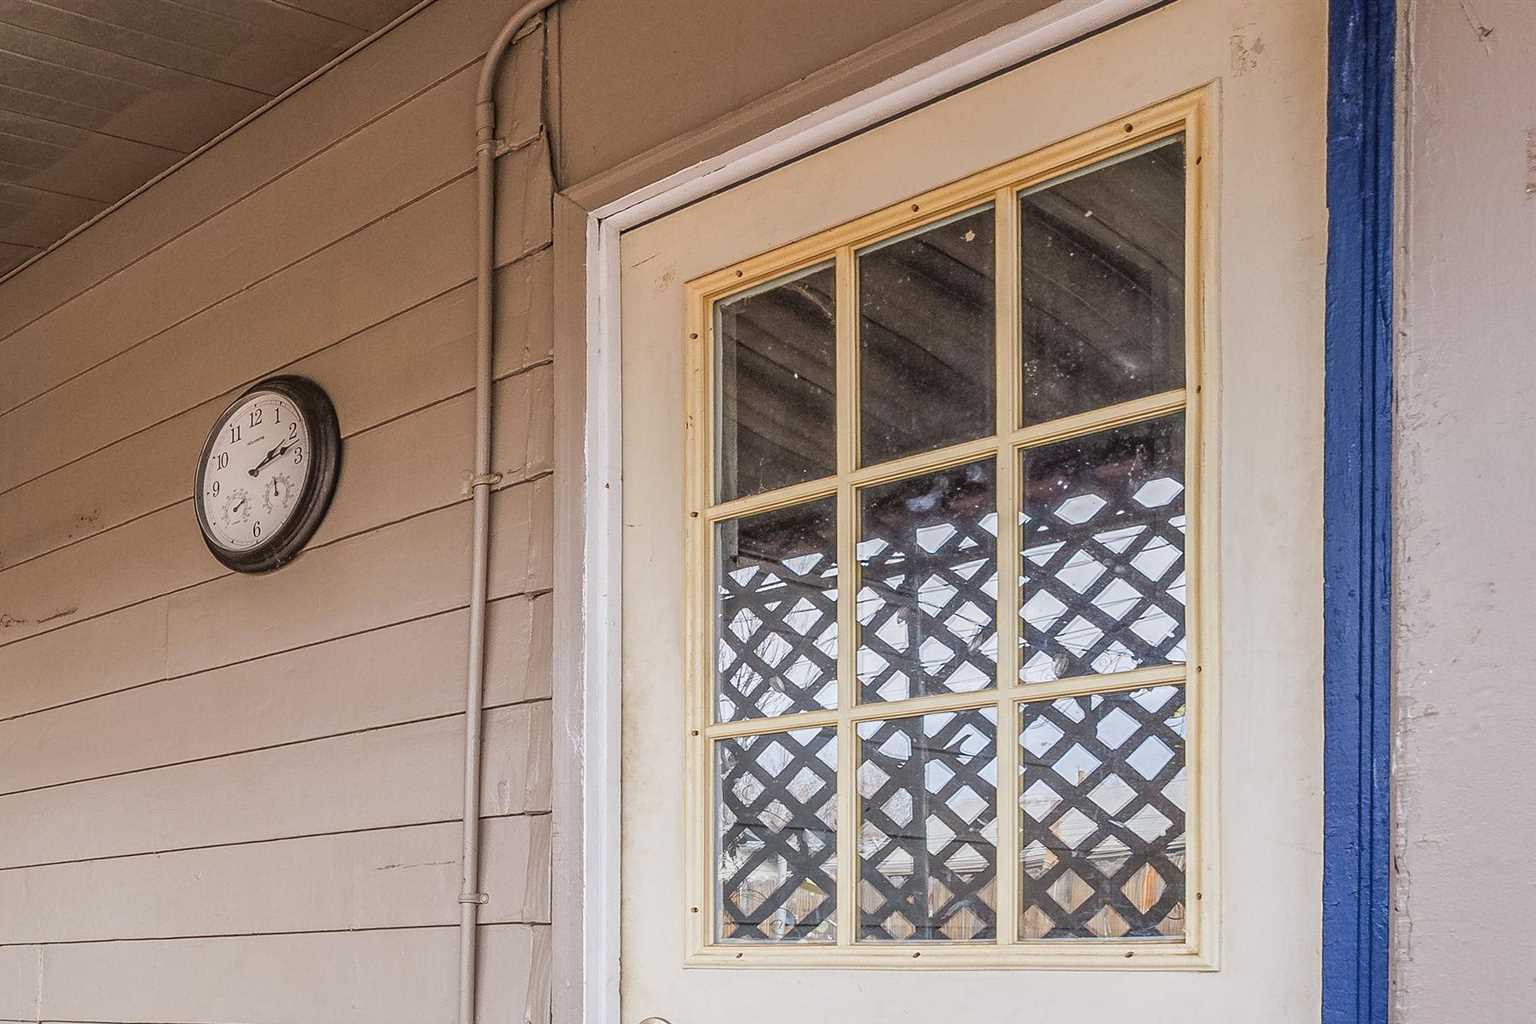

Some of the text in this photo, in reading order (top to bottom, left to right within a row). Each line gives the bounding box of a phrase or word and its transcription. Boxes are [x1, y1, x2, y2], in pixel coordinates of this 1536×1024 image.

[249, 408, 263, 428] 12
[274, 407, 280, 425] 1
[230, 425, 242, 444] 11
[289, 422, 298, 440] 2
[217, 452, 229, 471] 10
[294, 446, 303, 464] 3
[212, 480, 220, 497] 9
[253, 520, 261, 538] 6
